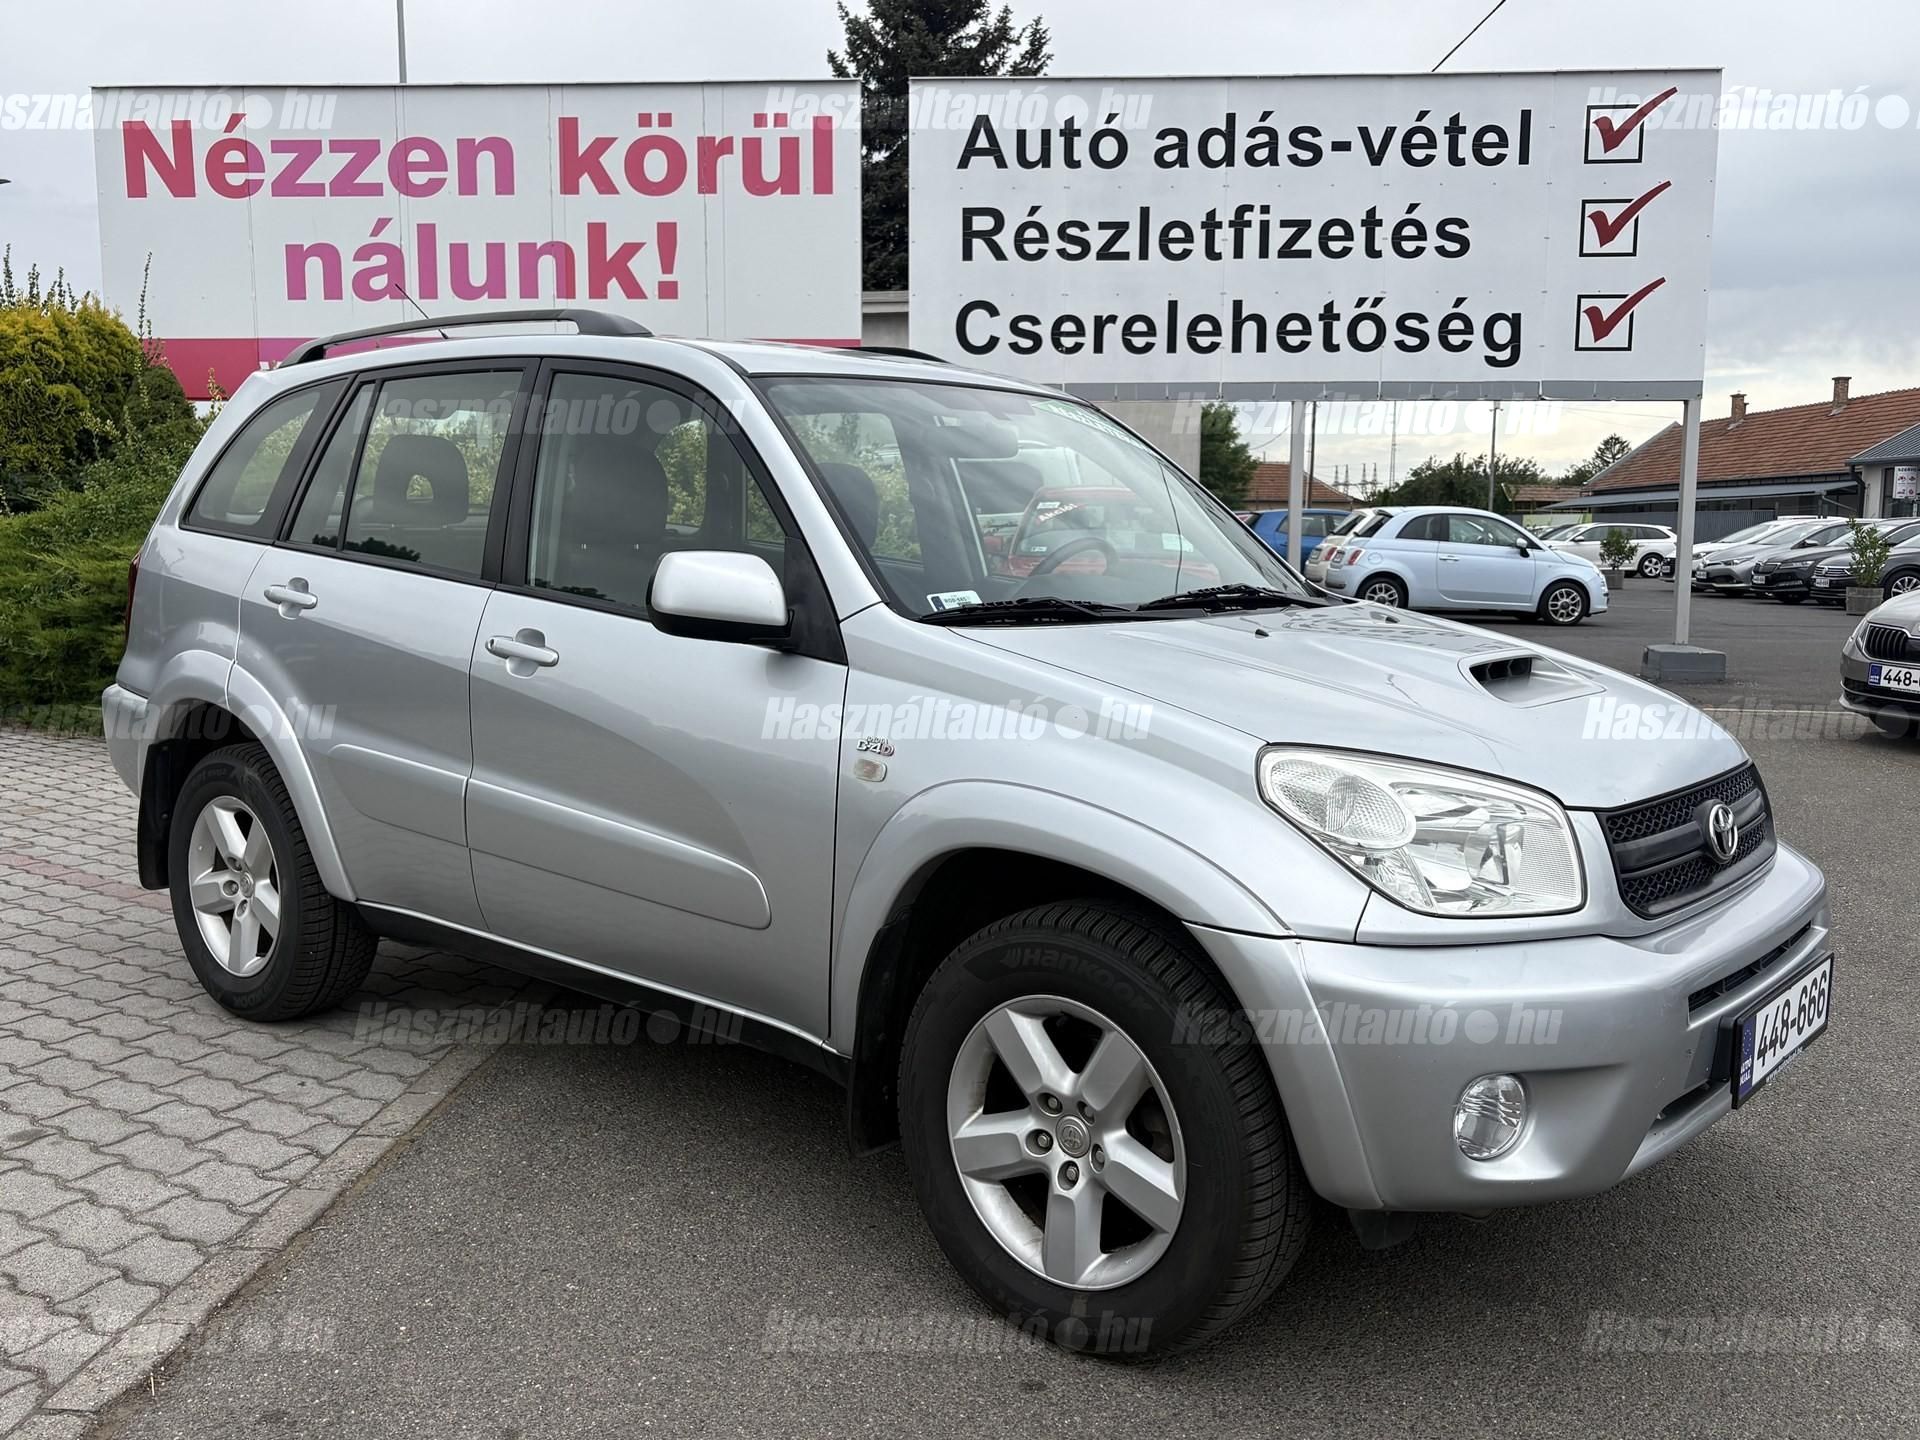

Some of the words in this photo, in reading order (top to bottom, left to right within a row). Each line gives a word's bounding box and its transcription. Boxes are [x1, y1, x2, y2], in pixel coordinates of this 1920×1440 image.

[124, 114, 513, 198] Nézzen
[560, 114, 832, 196] körül
[958, 113, 1128, 169] Autó
[1154, 110, 1531, 168] adás-vétel
[287, 219, 677, 300] nálunk!
[963, 203, 1470, 261] Részletfizetés
[956, 297, 1521, 367] Cserelehetőség
[1883, 669, 1920, 686] 448-
[1757, 970, 1828, 1067] 448-666
